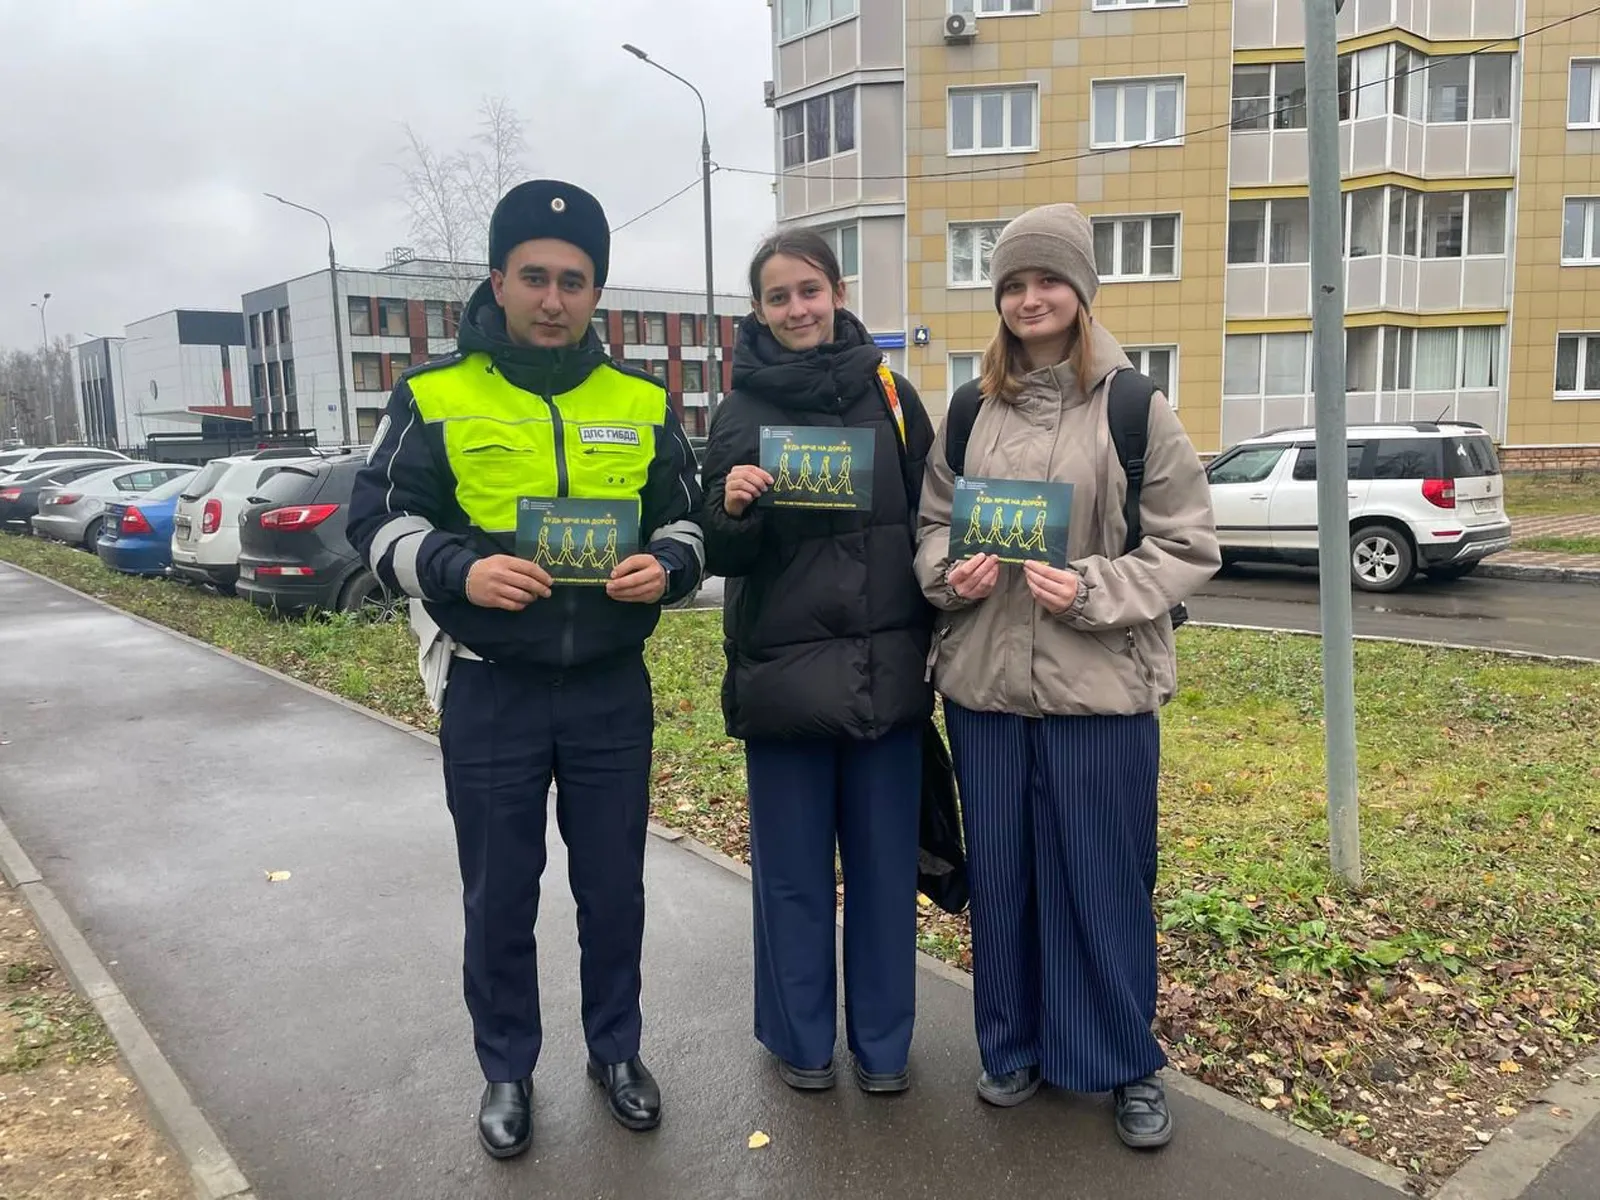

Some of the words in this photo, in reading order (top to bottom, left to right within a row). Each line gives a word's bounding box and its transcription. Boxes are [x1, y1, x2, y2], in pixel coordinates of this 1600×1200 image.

[583, 429, 604, 439] ДПС
[606, 429, 637, 442] ГИБДД
[827, 445, 852, 453] ДОРОГЕ
